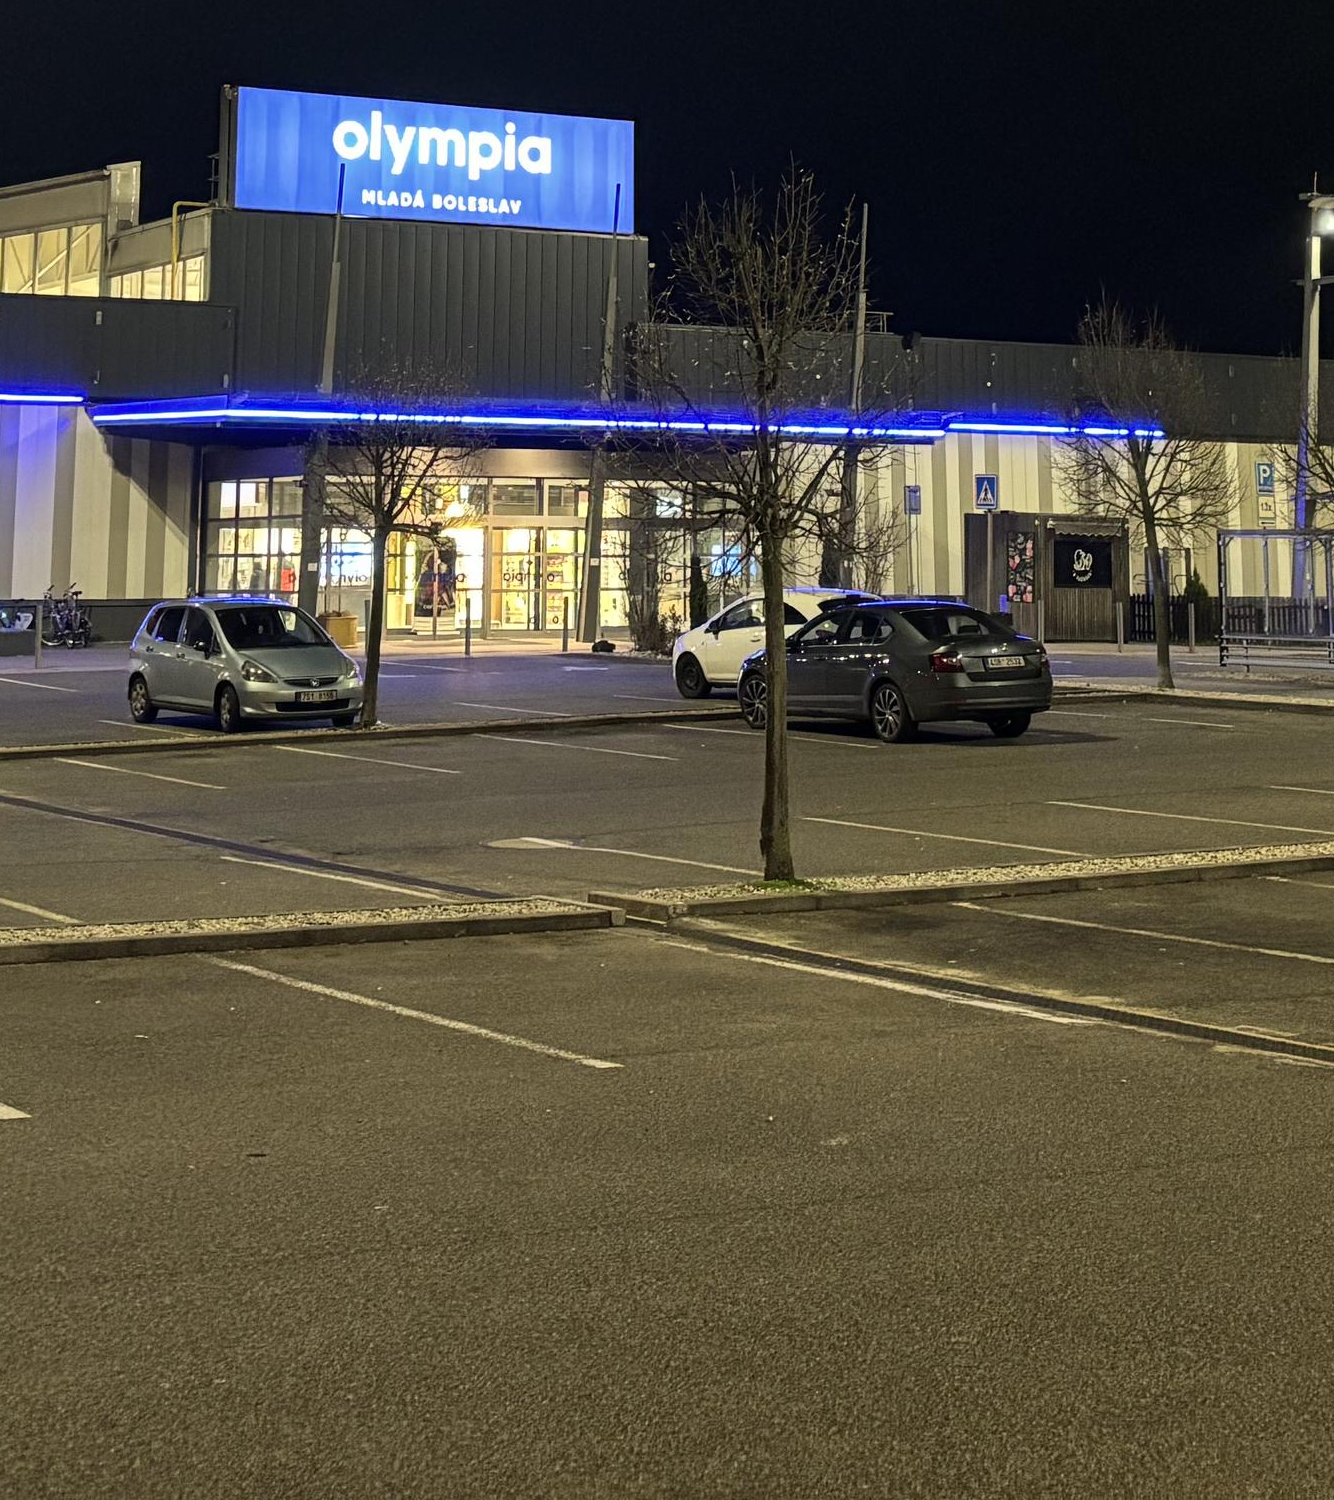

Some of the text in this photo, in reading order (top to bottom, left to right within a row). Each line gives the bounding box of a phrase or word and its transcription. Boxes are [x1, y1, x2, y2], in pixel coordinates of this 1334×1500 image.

[332, 110, 552, 181] olympia
[361, 188, 522, 215] MLADÁ BOLESLAV
[1259, 465, 1271, 485] P
